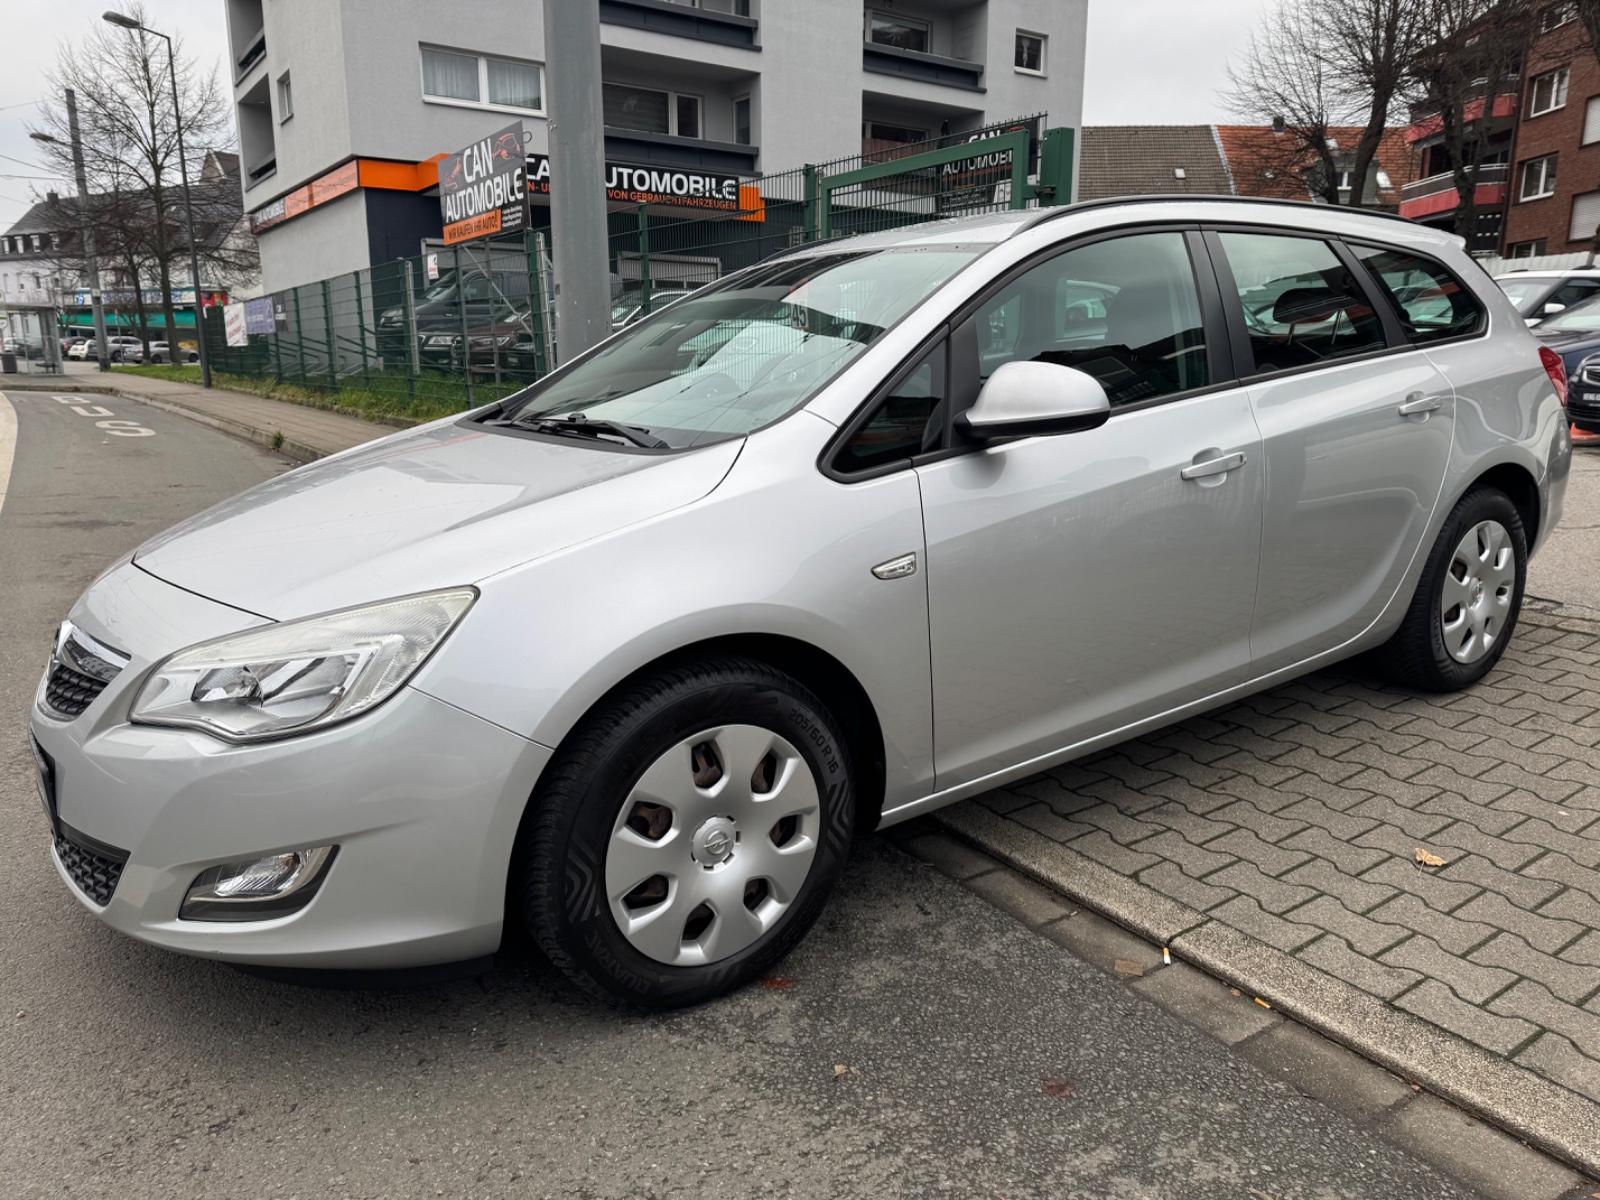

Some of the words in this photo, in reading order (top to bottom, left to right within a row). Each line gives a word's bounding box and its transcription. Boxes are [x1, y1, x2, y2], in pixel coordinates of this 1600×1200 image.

[463, 138, 494, 183] CAN
[446, 167, 524, 223] AUTOMOBILE
[604, 166, 737, 200] UTOMOBILE
[607, 189, 630, 200] VON
[51, 395, 156, 437] BUS
[787, 707, 826, 747] 205/60
